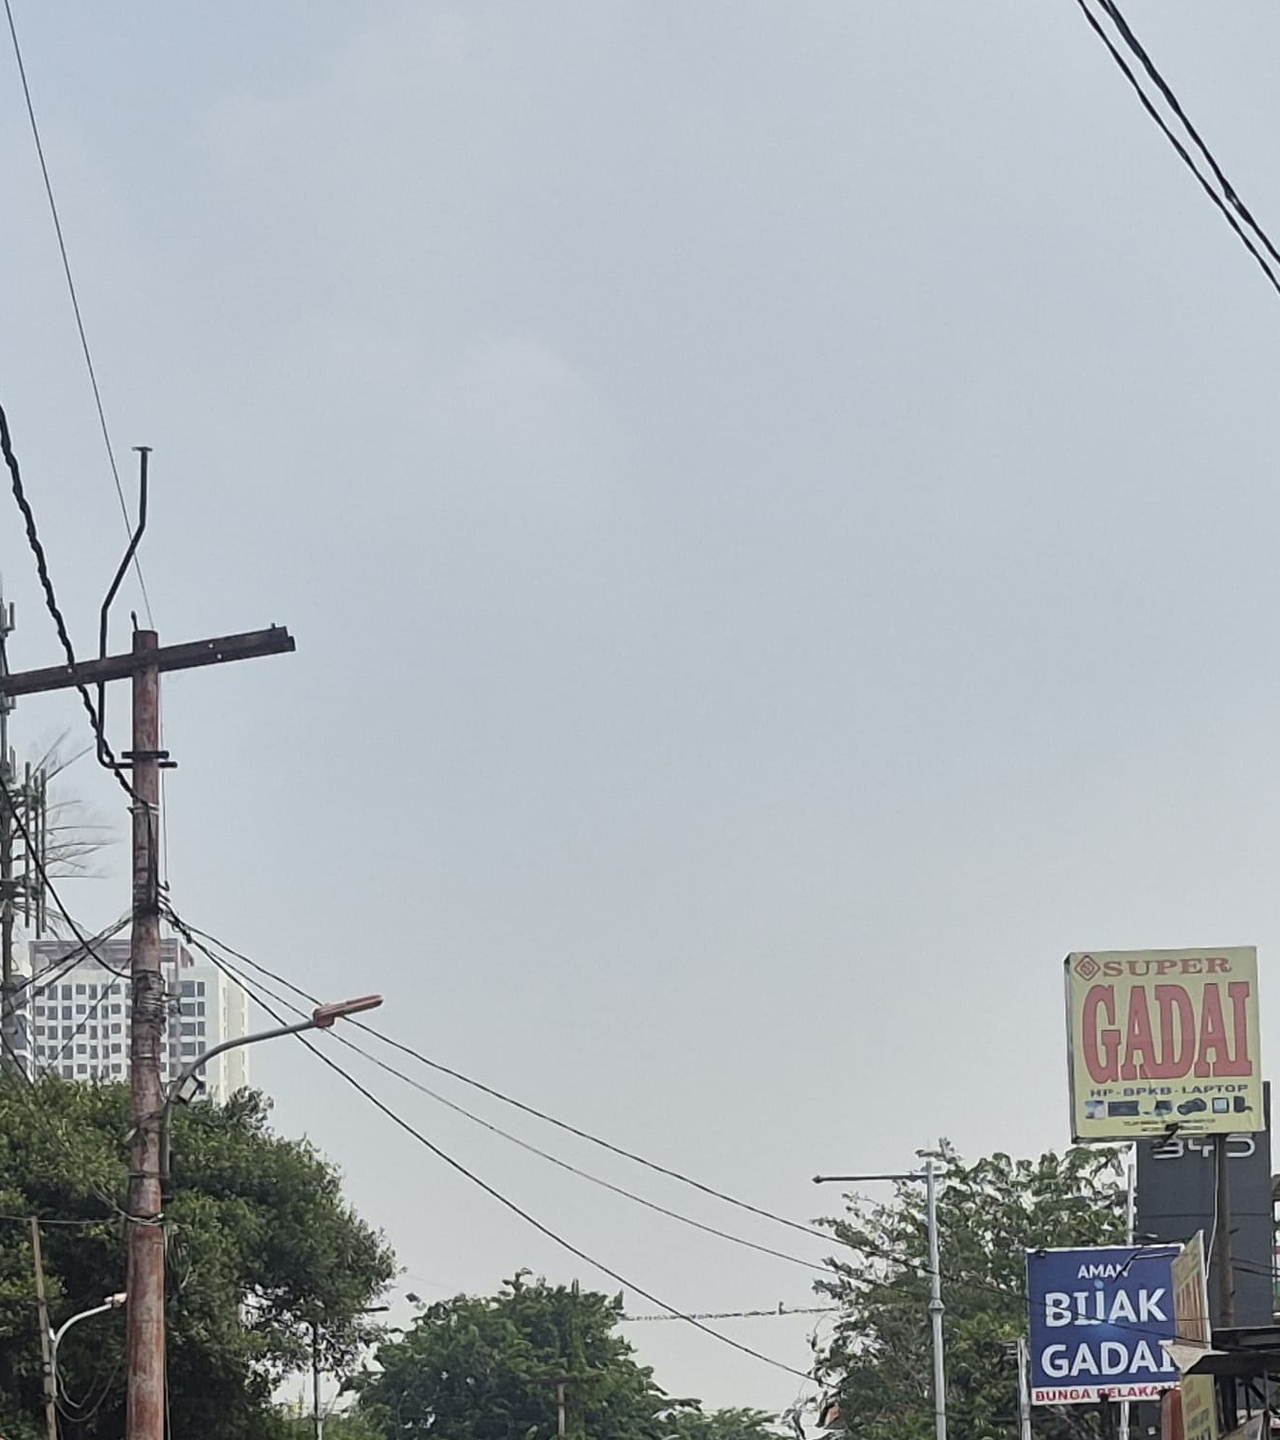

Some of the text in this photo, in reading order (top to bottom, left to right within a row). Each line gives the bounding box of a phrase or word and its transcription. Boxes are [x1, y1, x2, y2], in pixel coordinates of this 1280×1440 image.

[1103, 957, 1233, 977] SUPER
[1082, 981, 1253, 1084] GADAI
[1077, 1263, 1129, 1279] AMAN
[1035, 1384, 1181, 1402] BUNGA BELAKA
